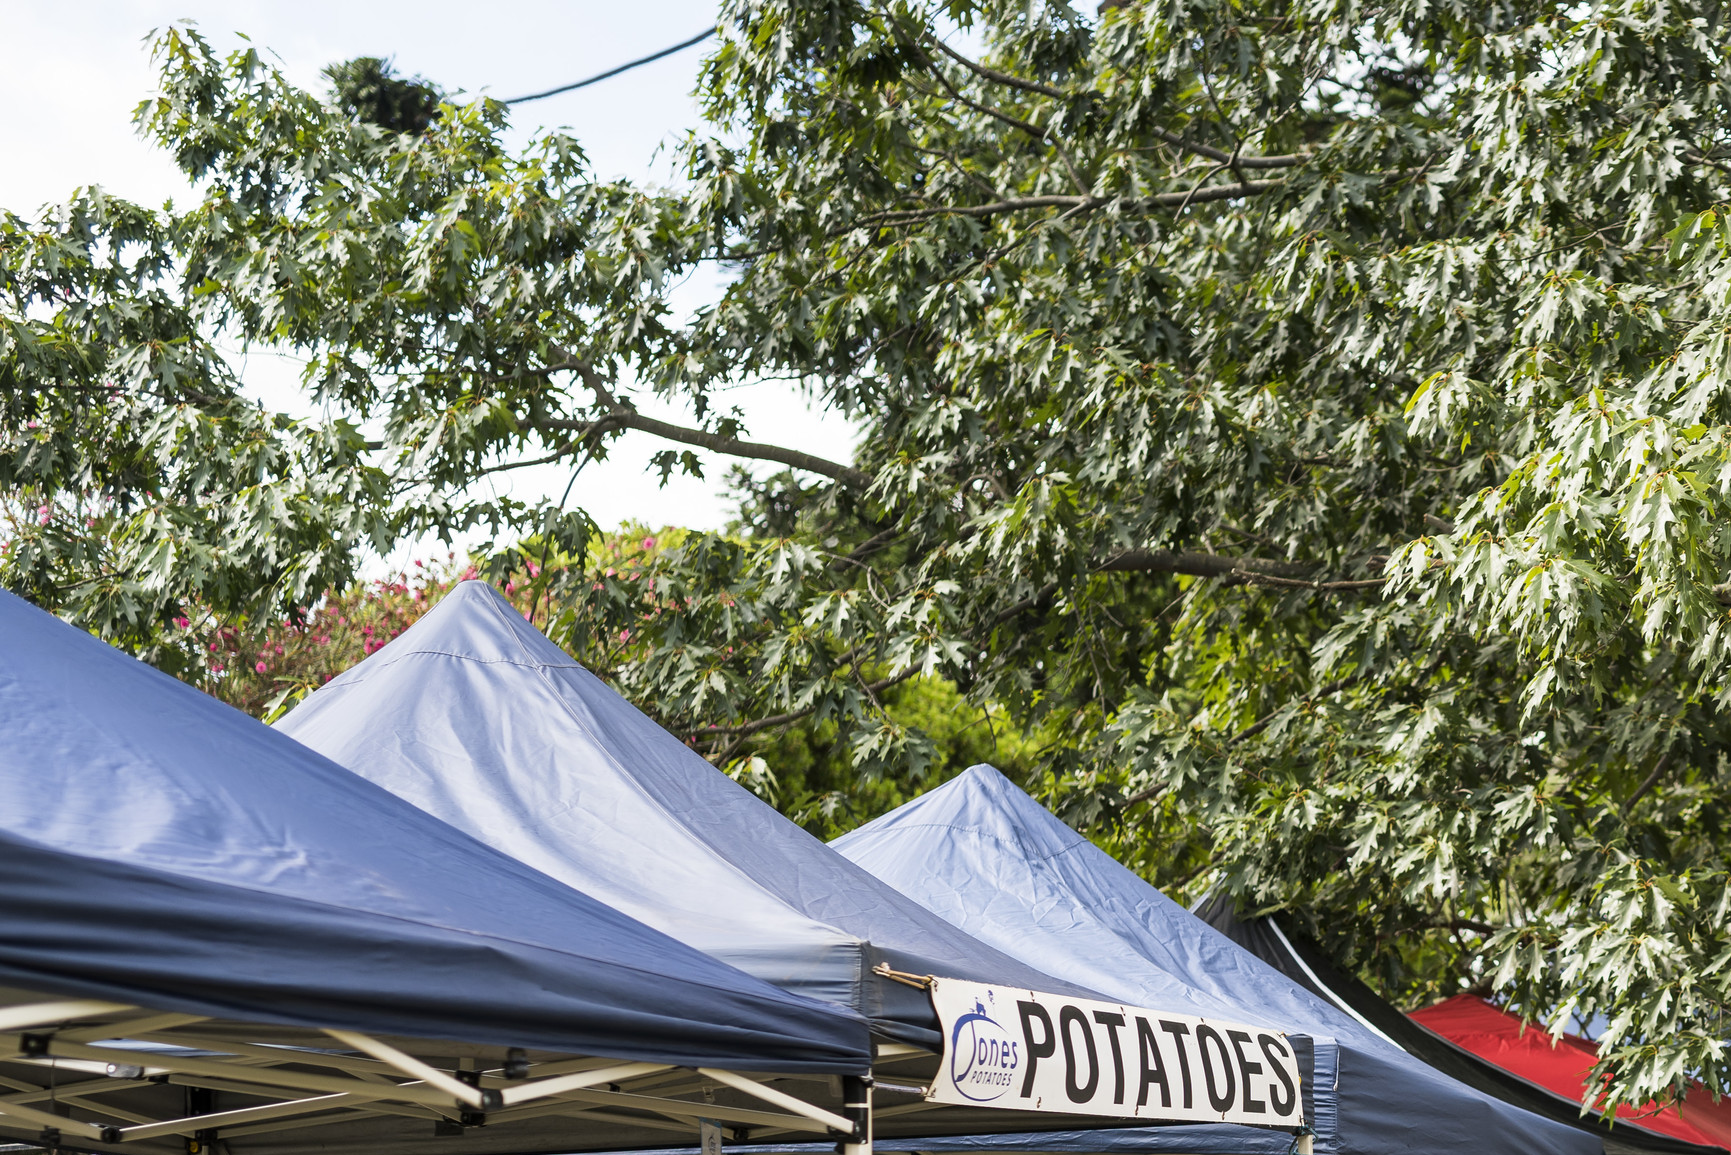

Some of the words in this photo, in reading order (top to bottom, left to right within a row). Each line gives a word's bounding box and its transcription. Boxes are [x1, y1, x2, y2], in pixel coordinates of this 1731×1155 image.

[953, 1013, 1018, 1083] Jones
[970, 1070, 1013, 1087] POTATOES
[1016, 1000, 1296, 1117] POTATOES
